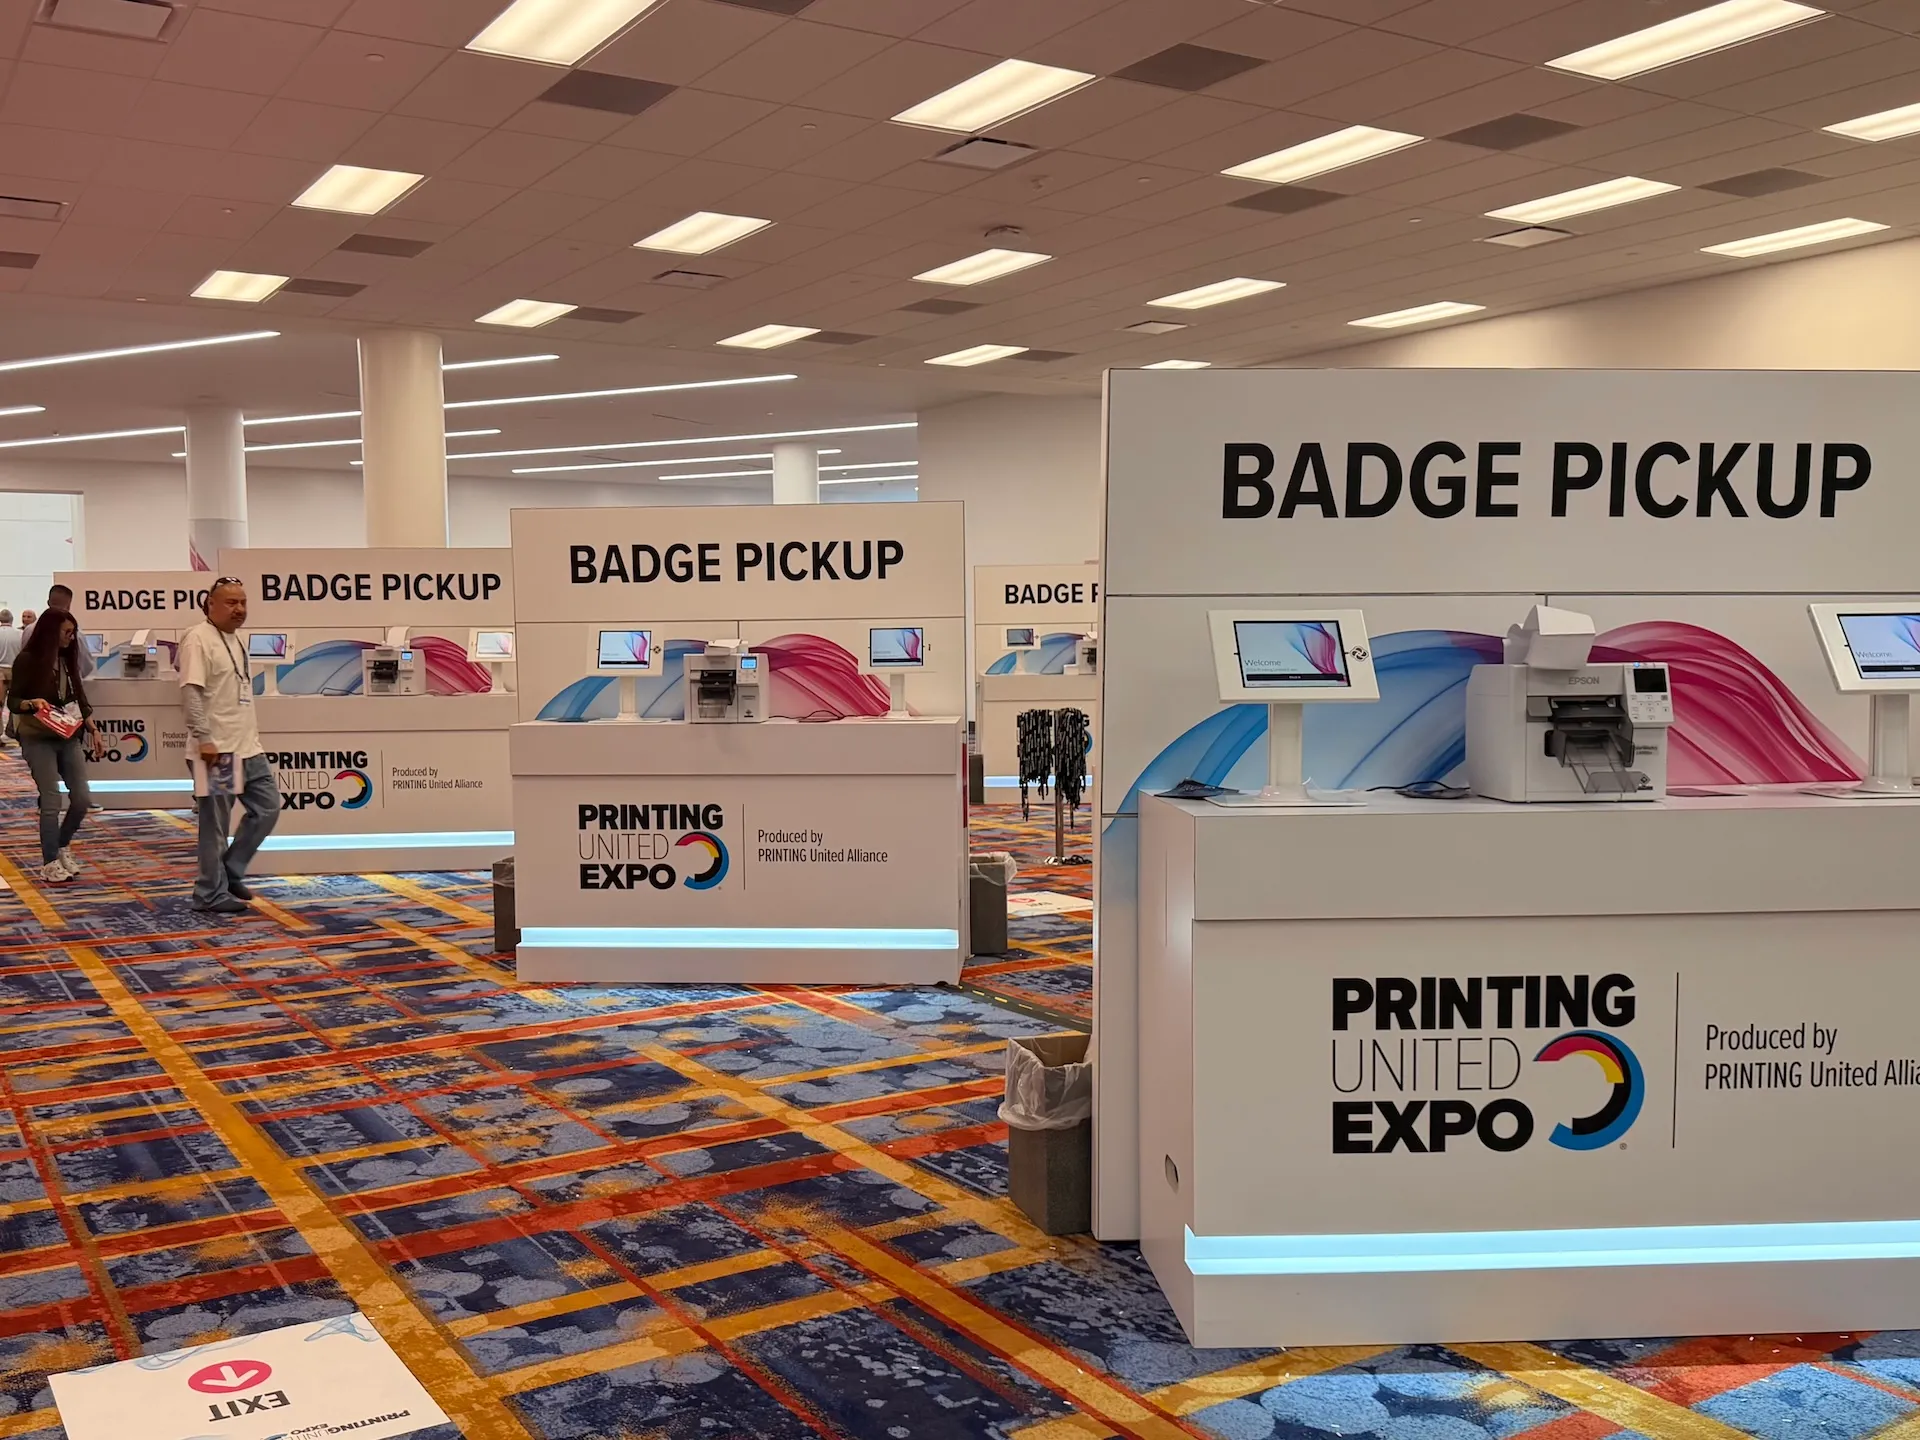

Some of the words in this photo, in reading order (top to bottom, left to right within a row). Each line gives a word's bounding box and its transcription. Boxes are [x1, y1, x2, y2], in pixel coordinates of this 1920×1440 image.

[1221, 440, 1522, 519] BADGE
[1550, 440, 1872, 518] PICKUP
[569, 543, 722, 584] BADGE
[736, 540, 905, 582] PICKUP
[85, 590, 166, 610] BADGE
[173, 589, 210, 610] PIC
[261, 573, 372, 601] BADGE
[382, 573, 501, 601] PICKUP
[1004, 583, 1083, 605] BADGE
[1244, 659, 1281, 667] Welcome
[1568, 676, 1600, 685] EPSON
[264, 750, 368, 769] PRINTING
[392, 767, 427, 776] Produced
[429, 766, 438, 778] by
[273, 771, 330, 790] NITED
[392, 780, 427, 789] PRINTING
[429, 779, 453, 789] United
[454, 779, 483, 788] Alliance
[280, 792, 335, 810] XPO
[578, 803, 724, 830] PRINTING
[578, 833, 669, 860] UNITED
[758, 829, 807, 843] Produced
[810, 829, 823, 846] by
[758, 848, 807, 862] PRINTING
[810, 848, 844, 862] United
[847, 848, 888, 862] Alliance
[580, 863, 676, 890] EXPO
[1332, 973, 1636, 1031] PRINTING
[1706, 1022, 1805, 1051] Produced
[1813, 1022, 1838, 1055] by
[1332, 1037, 1521, 1093] UNITED
[1705, 1061, 1802, 1090] PRINTING
[1810, 1060, 1878, 1088] United
[1332, 1098, 1534, 1154] EXPO
[208, 1390, 291, 1422] EXIT
[291, 1423, 328, 1435] EXPO
[328, 1409, 411, 1434] PRINTING
